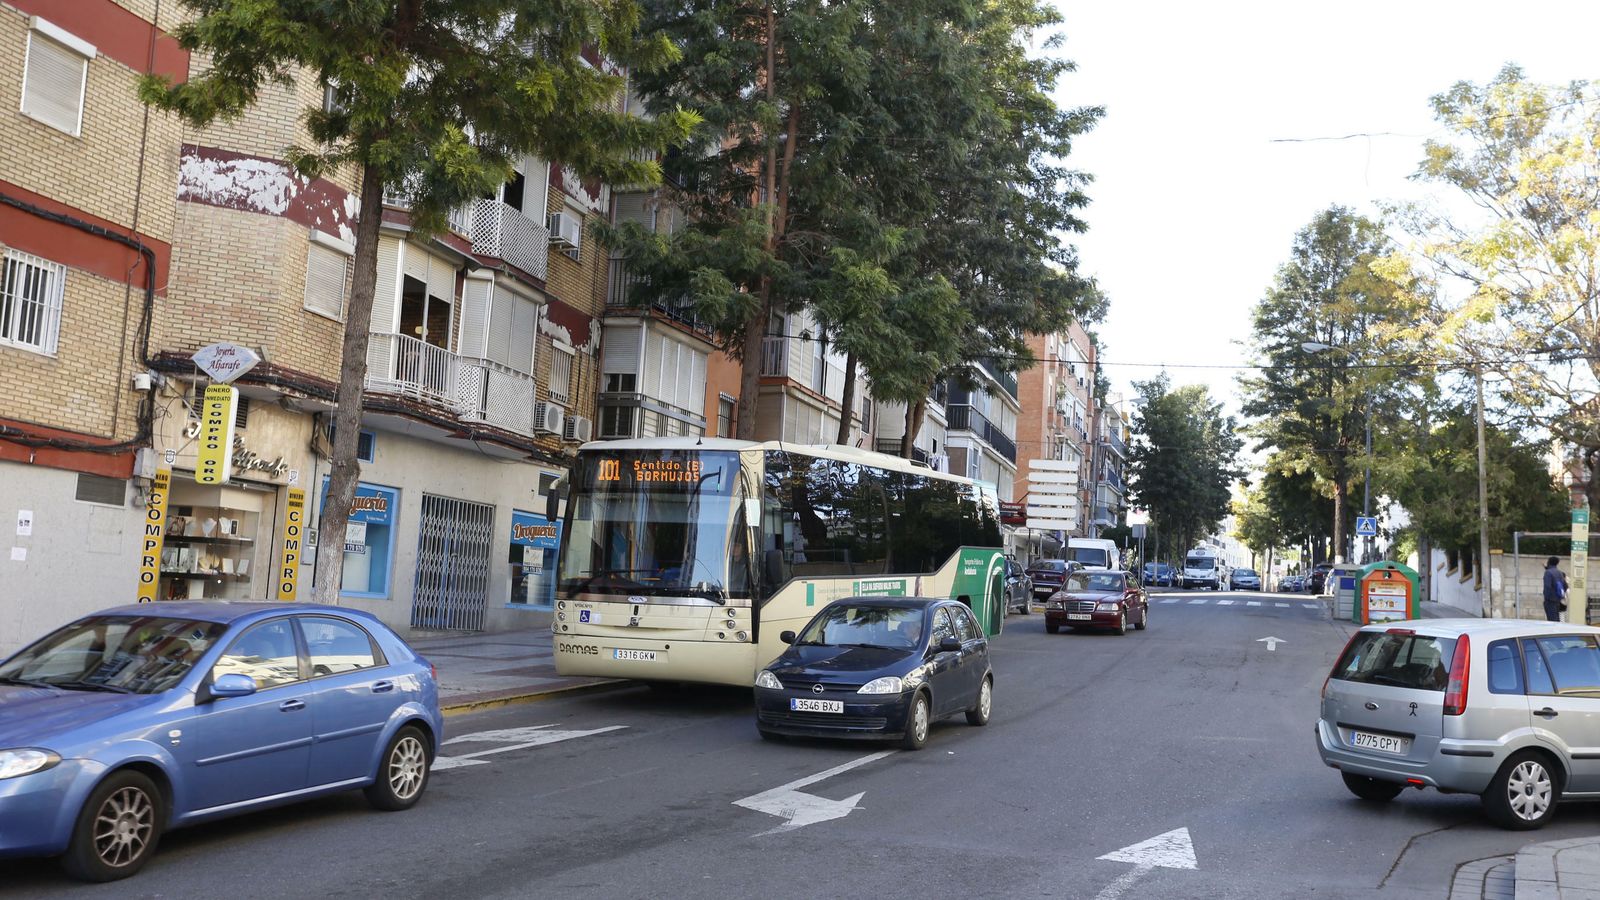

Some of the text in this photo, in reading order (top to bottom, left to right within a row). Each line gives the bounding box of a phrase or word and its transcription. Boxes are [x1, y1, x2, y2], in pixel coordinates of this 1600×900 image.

[214, 346, 236, 359] Joyería
[207, 359, 241, 373] Aljarafe
[203, 403, 222, 480] COMPRO ORO
[598, 459, 621, 481] 101
[633, 460, 681, 471] Sentido
[636, 471, 700, 482] BORMUJOS
[140, 493, 162, 584] COMPRO
[513, 522, 557, 542] Droguería
[282, 511, 300, 593] COMPRO
[560, 642, 599, 656] DAMAS
[618, 650, 638, 659] 3316
[798, 700, 840, 712] 3546 BXJ
[1356, 733, 1399, 751] 9775 CPY
